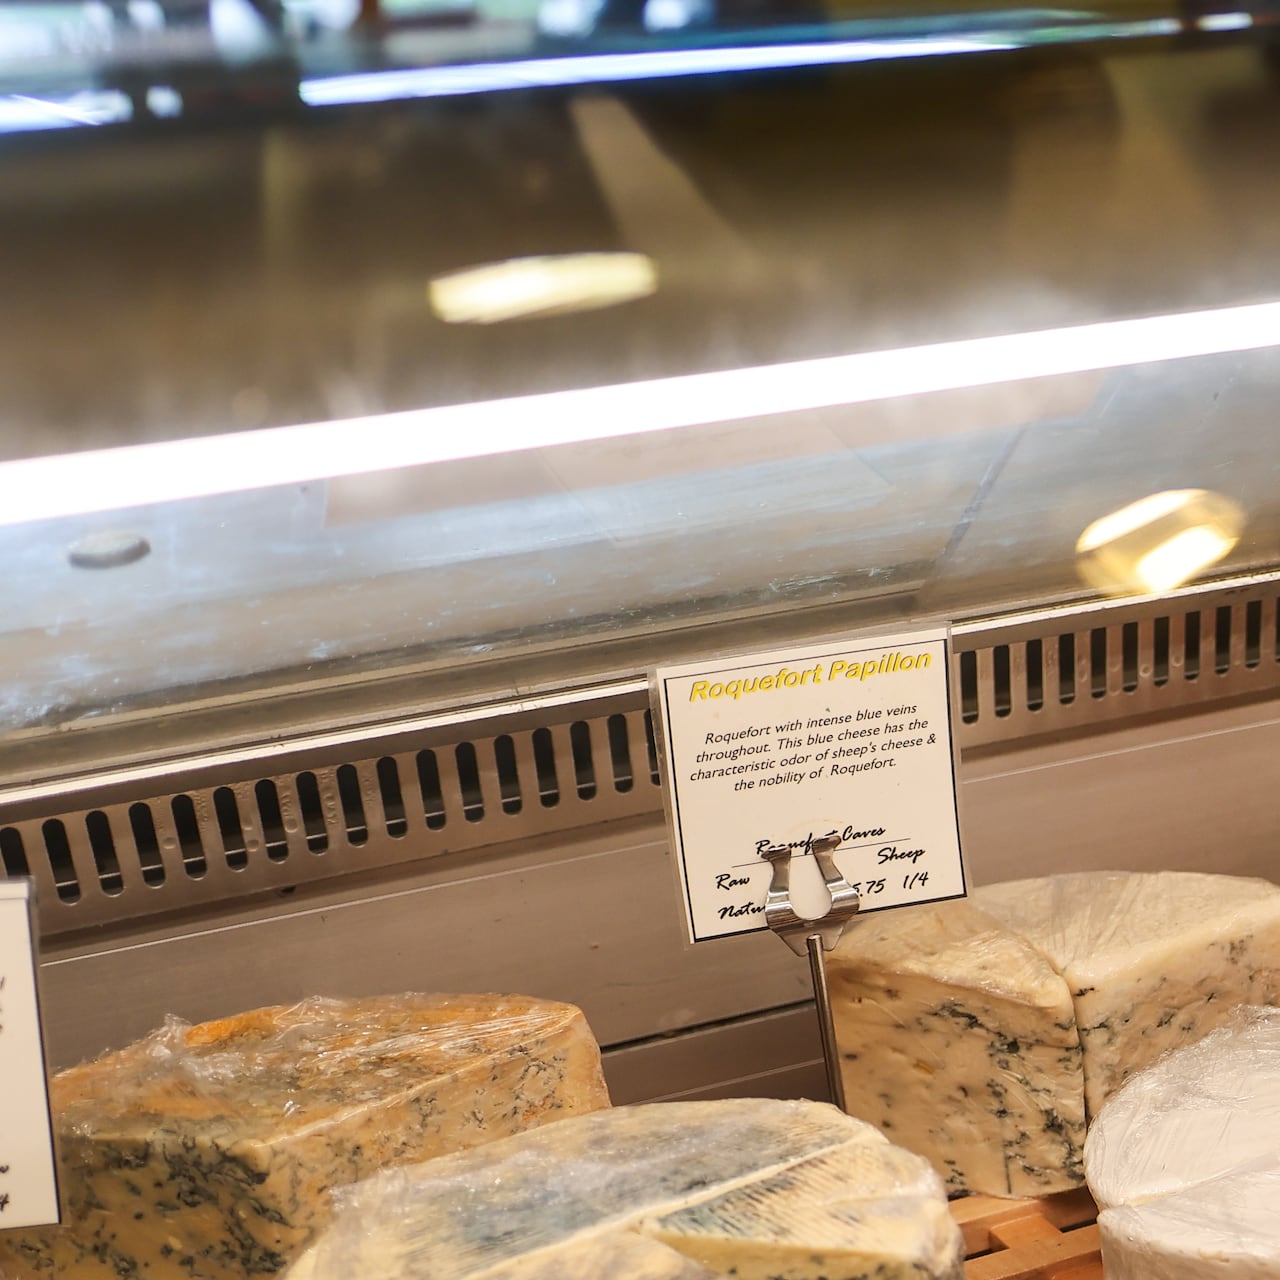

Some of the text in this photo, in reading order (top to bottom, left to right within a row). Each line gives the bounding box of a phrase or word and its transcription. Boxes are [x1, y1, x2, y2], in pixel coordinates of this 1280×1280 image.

[690, 653, 932, 702] Roquefort Papillon
[696, 718, 928, 763] throughout. This blue cheese has the
[704, 705, 917, 745] Roquefort with intense blue veins
[690, 733, 936, 781] characteristic odor of sheep's cheese &
[734, 758, 896, 791] the nobility of Roquefort.
[842, 825, 886, 841] Caves
[877, 846, 925, 865] Sheep
[715, 873, 750, 891] Raw
[903, 871, 929, 890] 1/4
